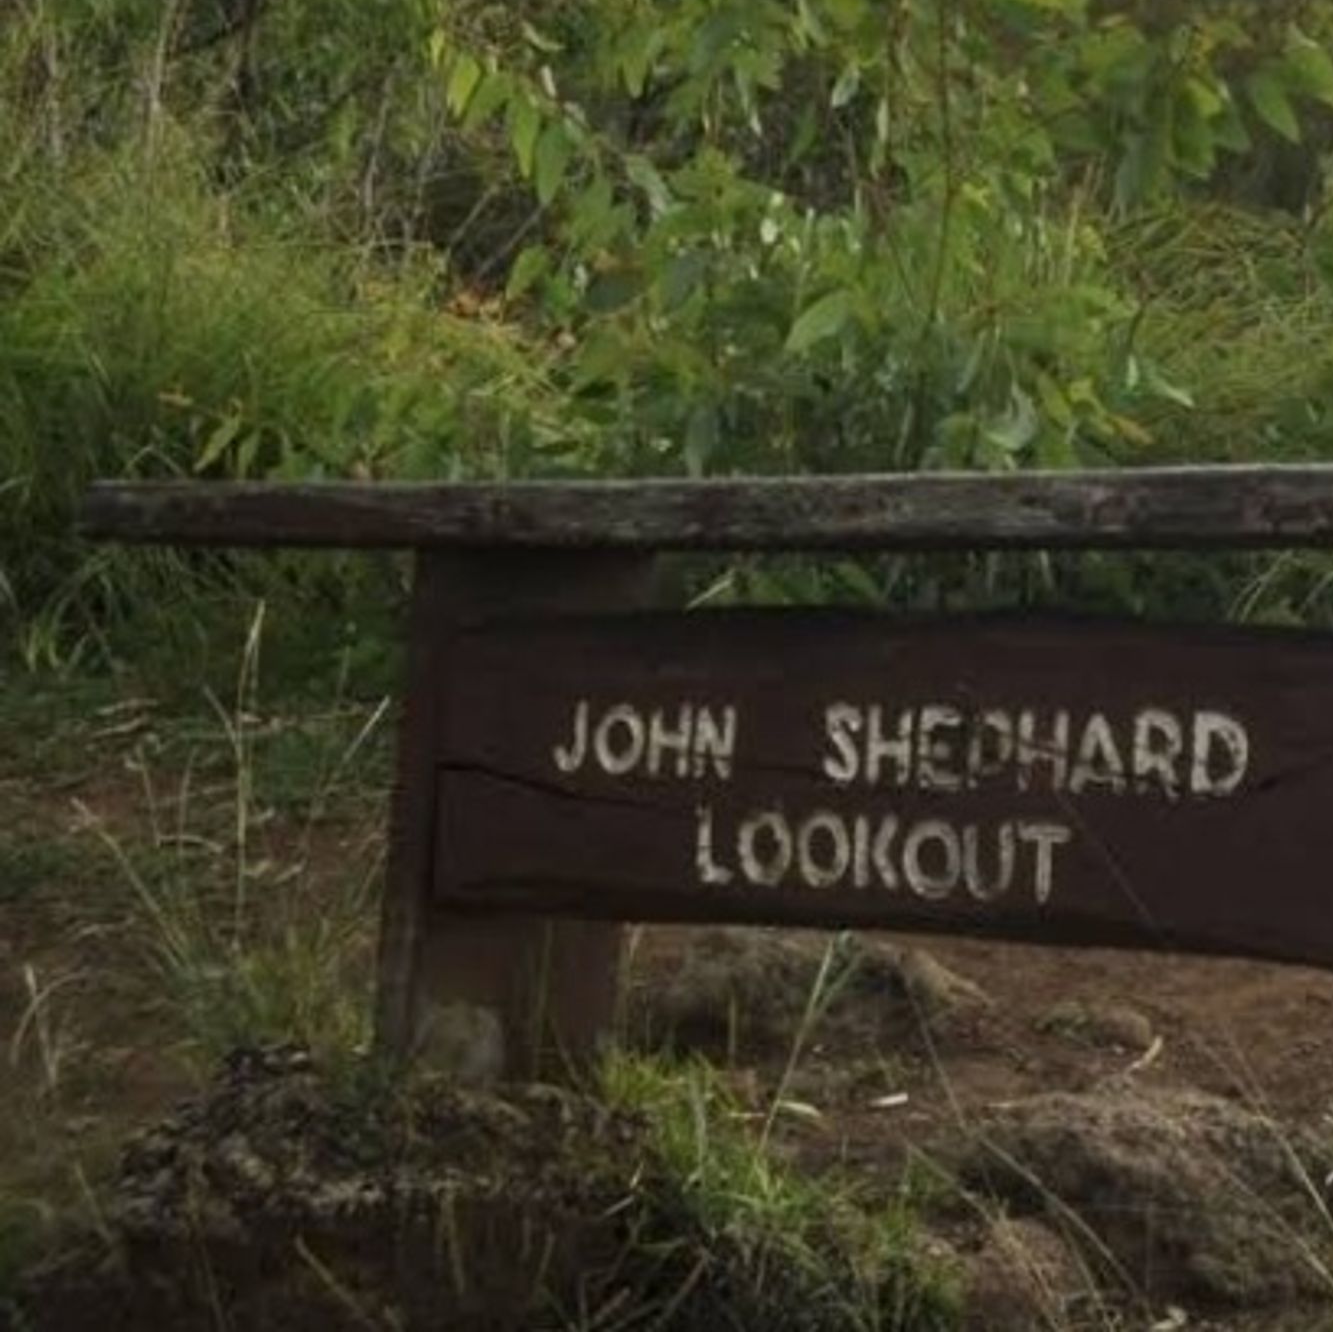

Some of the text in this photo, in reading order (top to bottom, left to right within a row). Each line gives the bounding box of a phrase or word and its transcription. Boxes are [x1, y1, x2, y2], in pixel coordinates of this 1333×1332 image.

[554, 700, 1249, 799] JOHN SHEPHARD
[694, 805, 1071, 904] LOOKOUT
